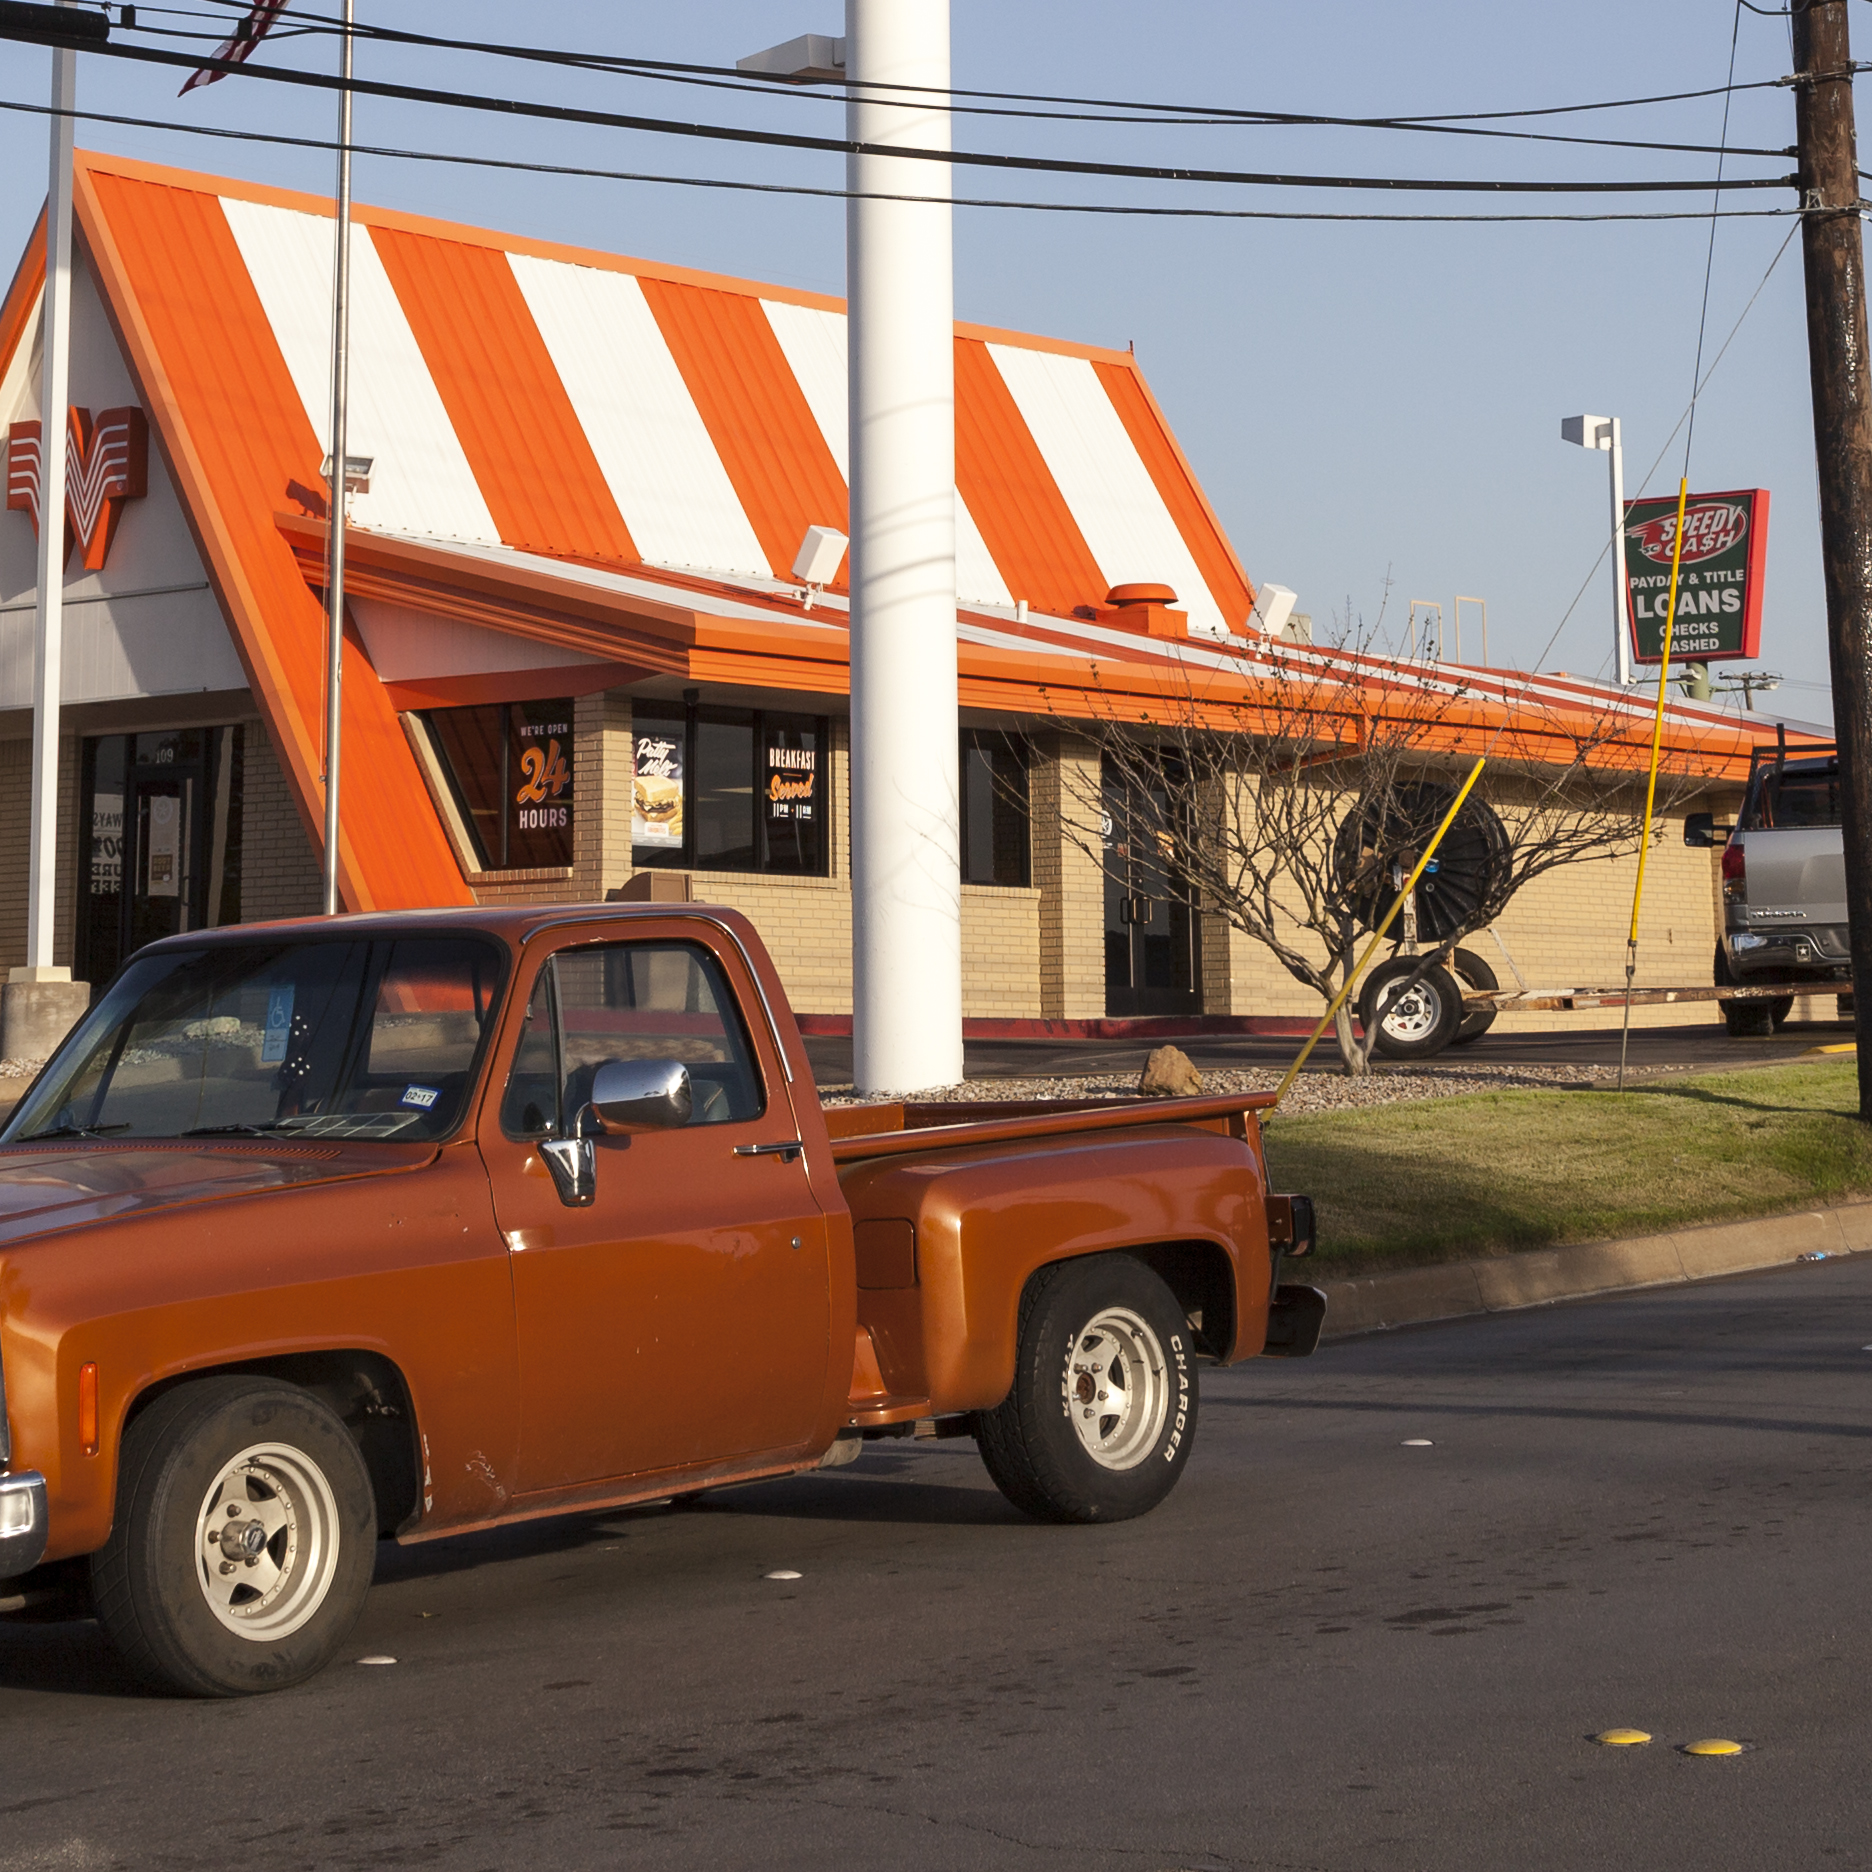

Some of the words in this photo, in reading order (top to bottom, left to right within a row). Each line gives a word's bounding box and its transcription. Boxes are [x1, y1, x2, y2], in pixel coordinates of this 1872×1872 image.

[1659, 505, 1743, 541] SPEEDY
[1689, 572, 1700, 585] &
[1703, 569, 1745, 583] TITLE
[1637, 588, 1741, 619] LOANS
[1659, 622, 1719, 637] CHECKS
[1660, 638, 1720, 653] CASHED
[520, 725, 545, 737] WE'RE
[547, 723, 568, 735] OPEN
[155, 747, 174, 764] 109
[636, 737, 677, 766] Patty
[769, 747, 816, 771] BREAKFAST
[516, 738, 571, 805] 24
[637, 758, 679, 778] Melt
[769, 772, 815, 802] Served
[519, 808, 568, 829] HOURS
[1164, 1334, 1189, 1462] CHARGER
